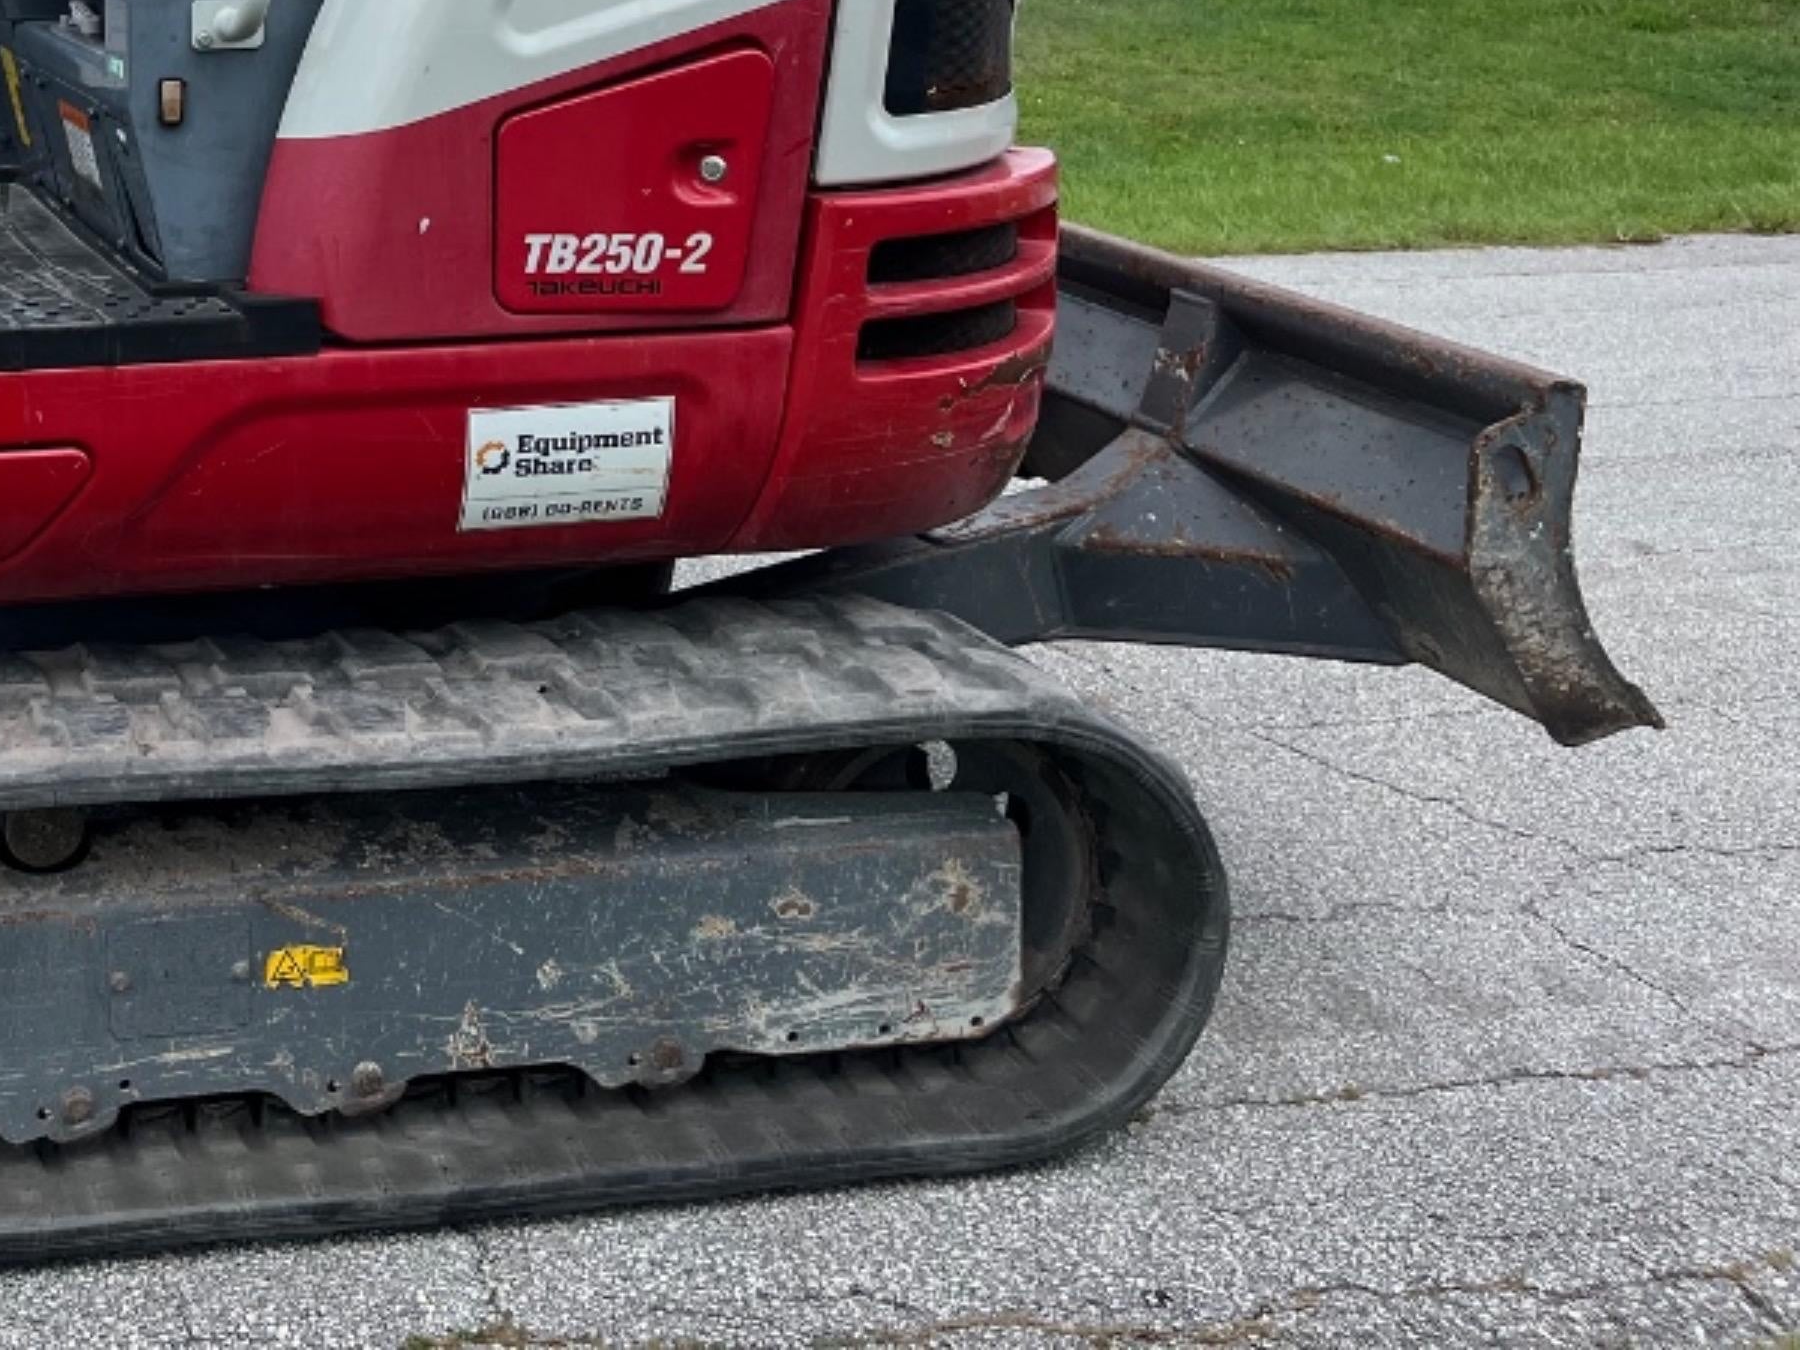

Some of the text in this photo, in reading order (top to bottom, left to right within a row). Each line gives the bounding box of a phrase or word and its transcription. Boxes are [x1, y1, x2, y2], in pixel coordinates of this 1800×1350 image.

[523, 232, 714, 275] TB250-2
[516, 426, 664, 456] Equipment
[515, 457, 593, 477] Share
